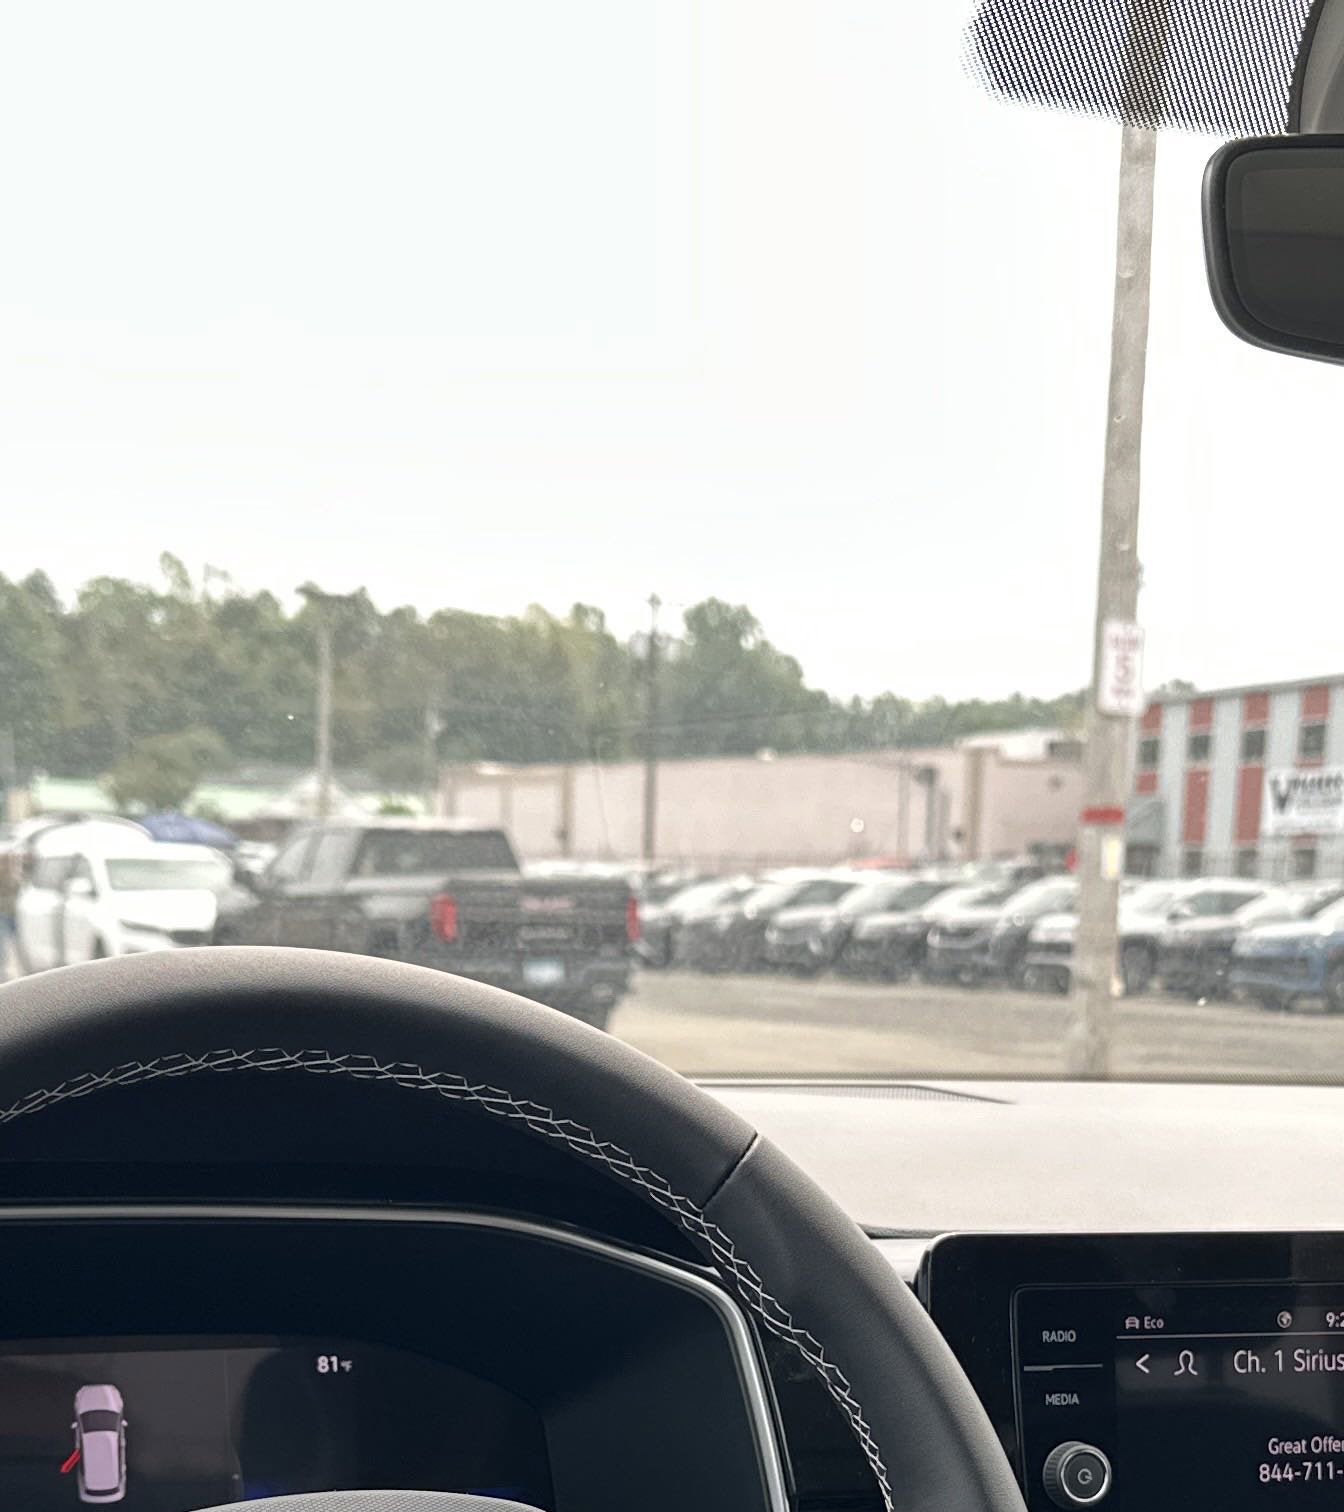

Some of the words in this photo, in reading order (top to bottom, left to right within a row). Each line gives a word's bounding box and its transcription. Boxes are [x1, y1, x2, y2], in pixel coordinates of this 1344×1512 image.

[1143, 1316, 1165, 1330] Eco
[1042, 1329, 1077, 1344] RADIO
[1233, 1350, 1267, 1374] Ch.
[1274, 1349, 1285, 1373] 1
[1045, 1393, 1080, 1406] MEDIA
[1267, 1436, 1308, 1456] Great
